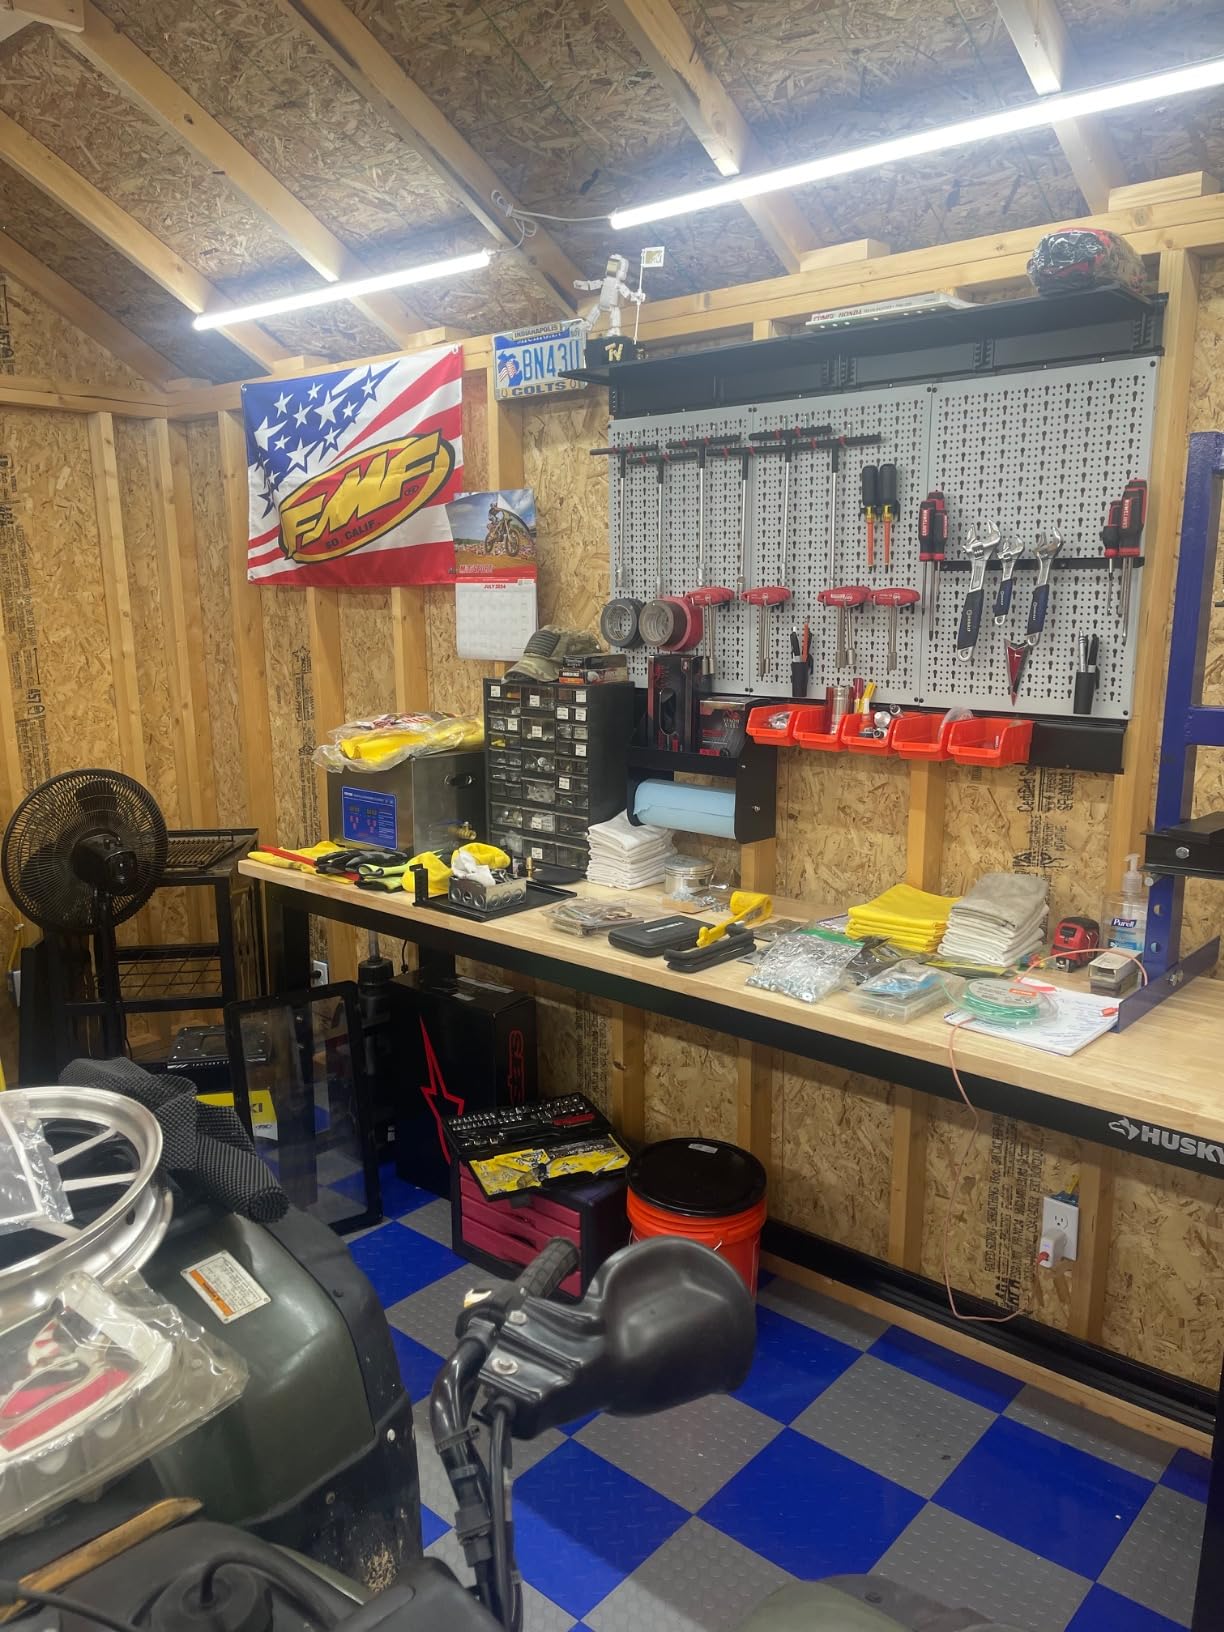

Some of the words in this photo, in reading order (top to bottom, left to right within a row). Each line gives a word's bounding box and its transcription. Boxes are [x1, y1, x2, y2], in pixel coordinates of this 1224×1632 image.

[511, 381, 567, 396] COLTS
[281, 431, 440, 559] FMF
[921, 508, 929, 537] CRAFTSMAN
[1113, 919, 1136, 928] Purell
